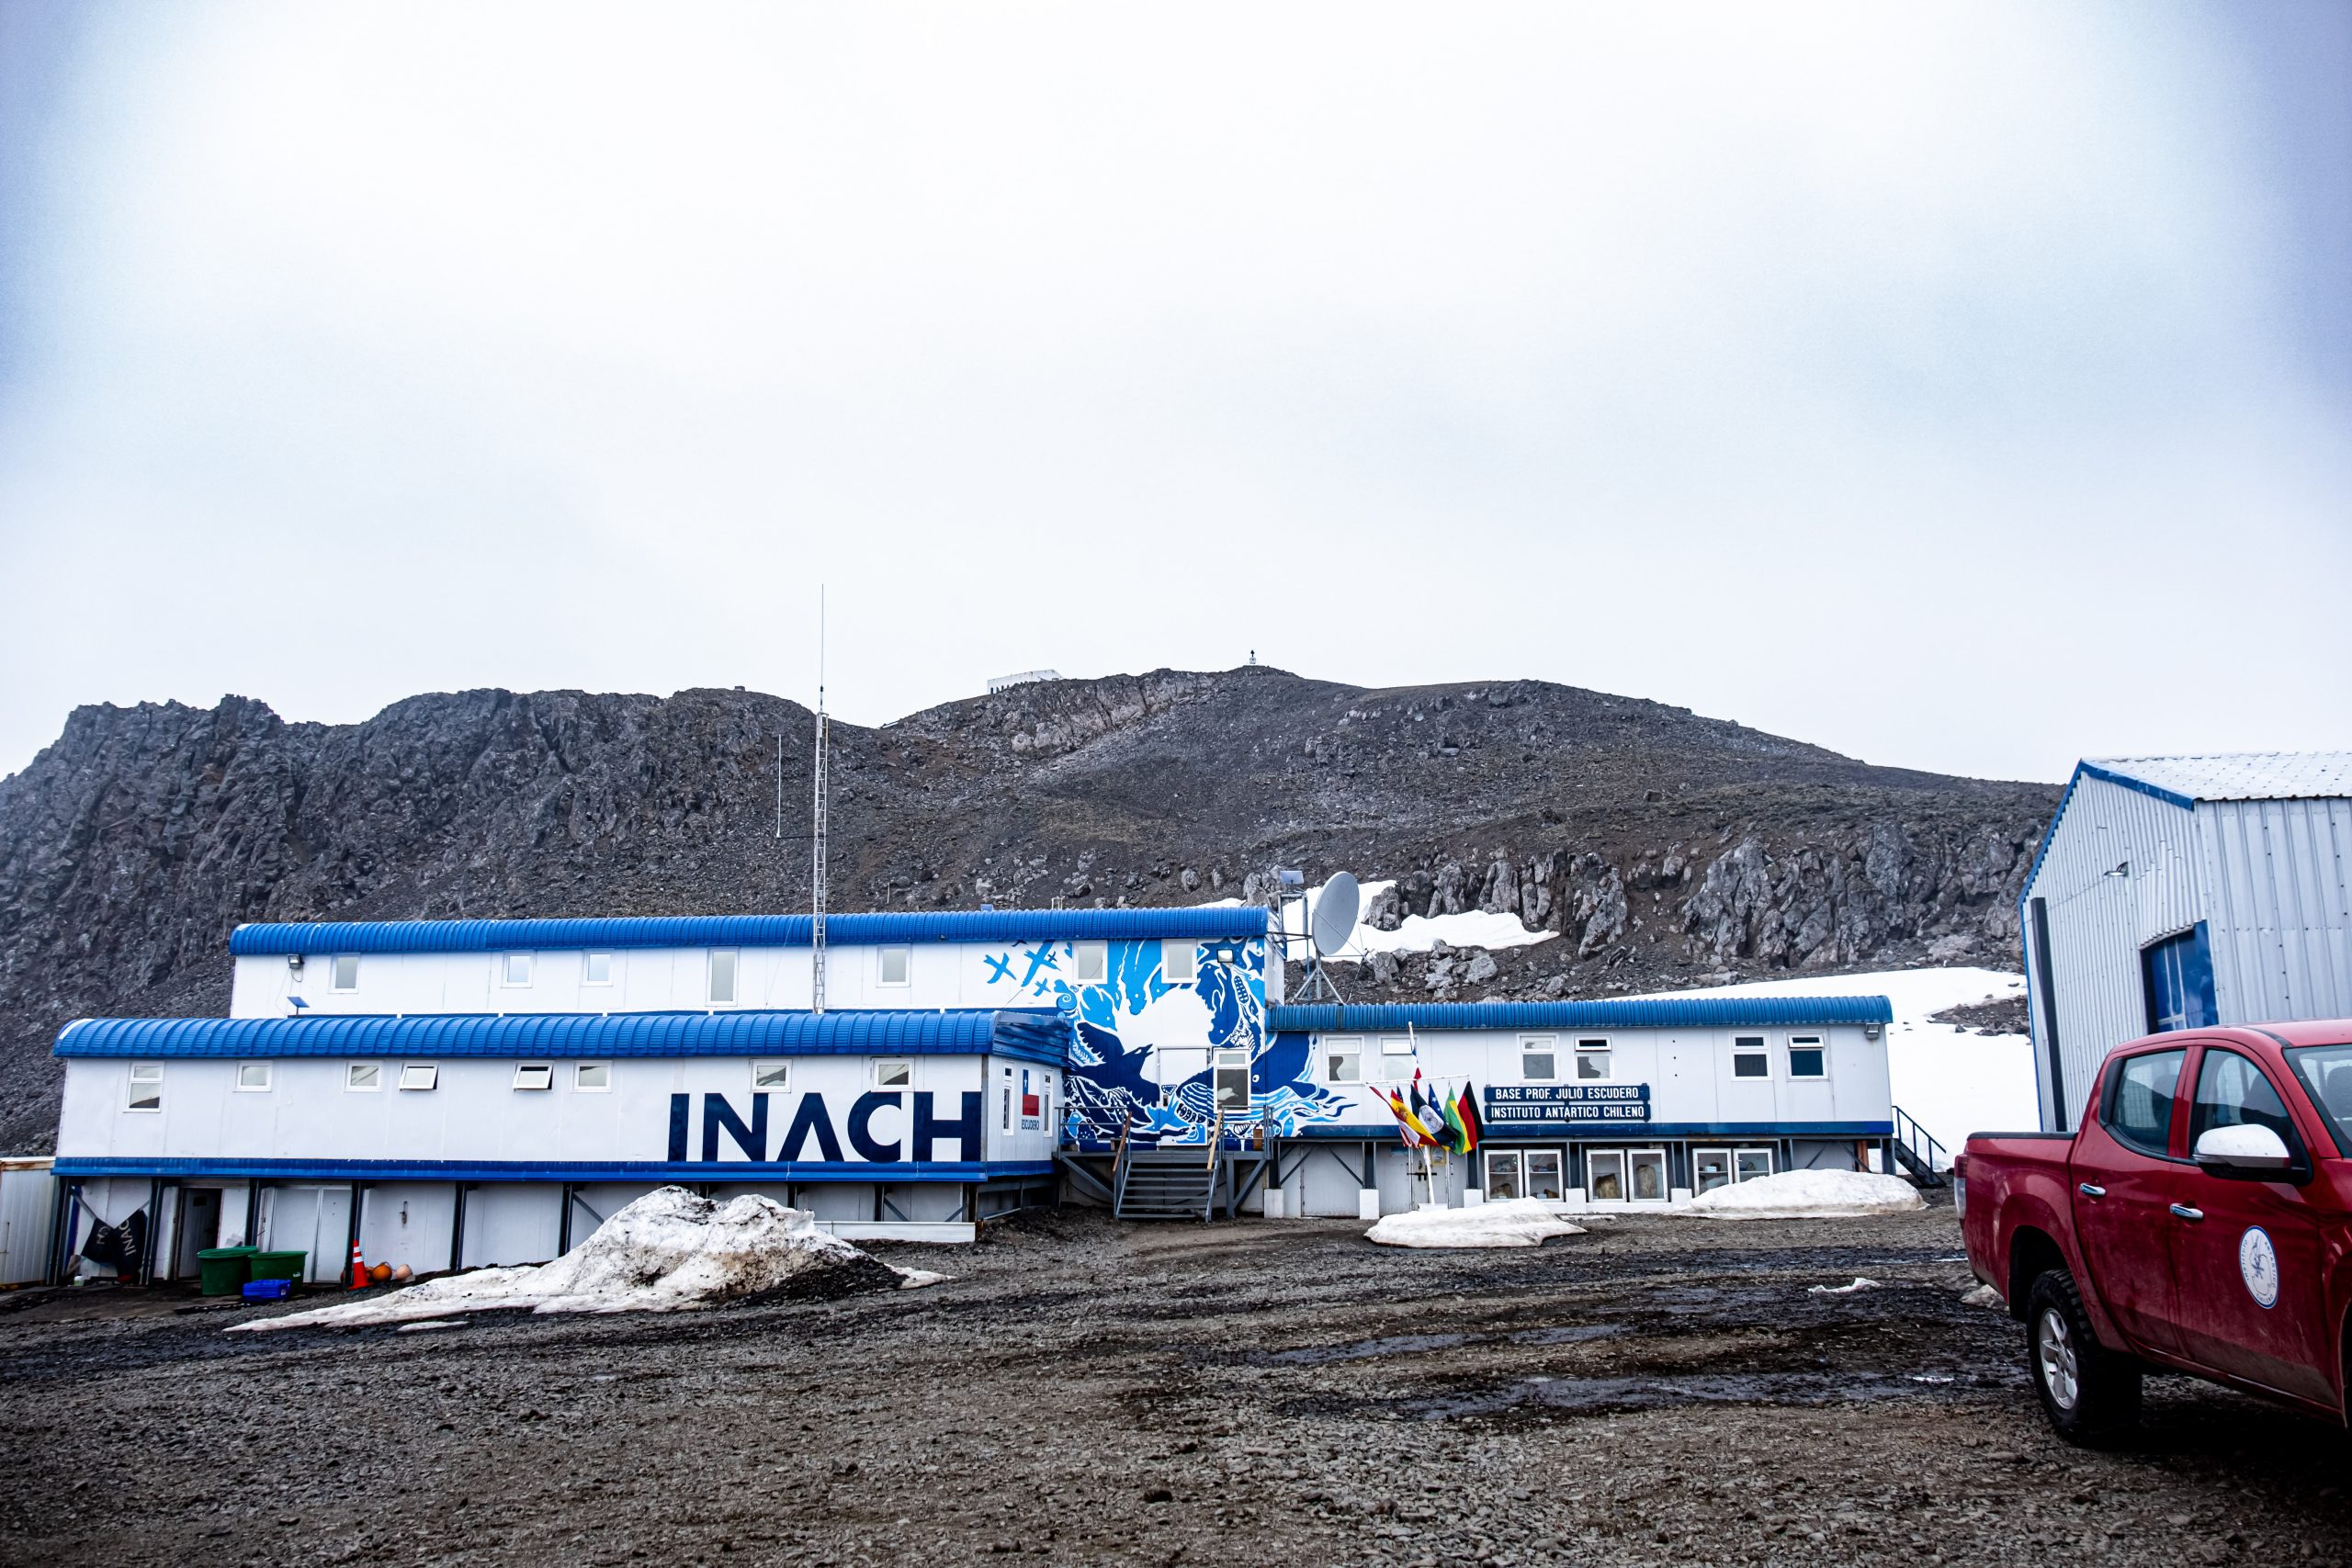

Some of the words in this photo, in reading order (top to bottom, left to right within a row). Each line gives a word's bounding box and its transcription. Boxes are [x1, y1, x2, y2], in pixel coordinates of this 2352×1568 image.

[1495, 1089, 1521, 1100] BASE
[1526, 1088, 1552, 1100] PROF.
[1555, 1088, 1583, 1099] JULIO
[1588, 1088, 1639, 1099] ESCUDERO
[1491, 1107, 1541, 1119] INSTITUTO
[1545, 1106, 1600, 1118] ANTARTICO
[1603, 1106, 1645, 1118] CHILENO
[667, 1090, 982, 1163] INACH
[1022, 1119, 1039, 1131] ESCUDERO
